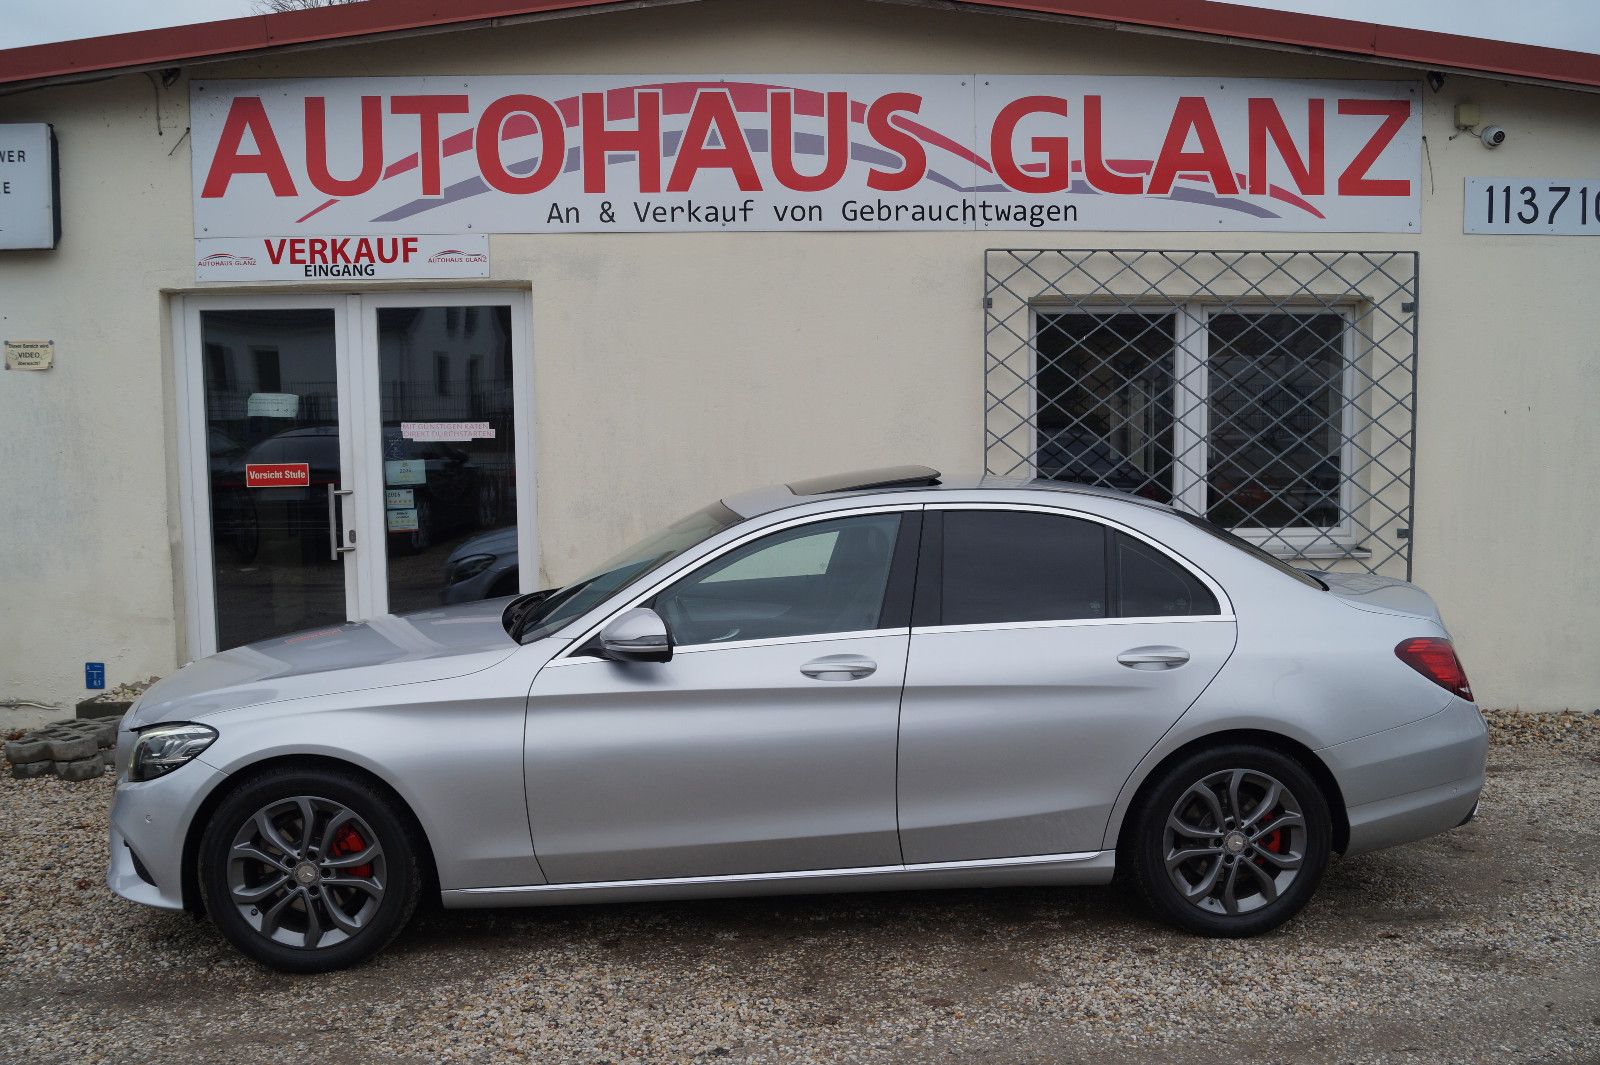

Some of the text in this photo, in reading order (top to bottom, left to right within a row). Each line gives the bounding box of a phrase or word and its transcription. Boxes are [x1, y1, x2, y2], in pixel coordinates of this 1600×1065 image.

[201, 91, 1411, 198] AUTOHAUS GLANZ
[547, 199, 1078, 227] An & Verkauf von Gebrauchtwagen
[264, 237, 418, 265] VERKAUF
[304, 263, 375, 277] EINGANG
[249, 470, 306, 479] Vorsicht Stufe
